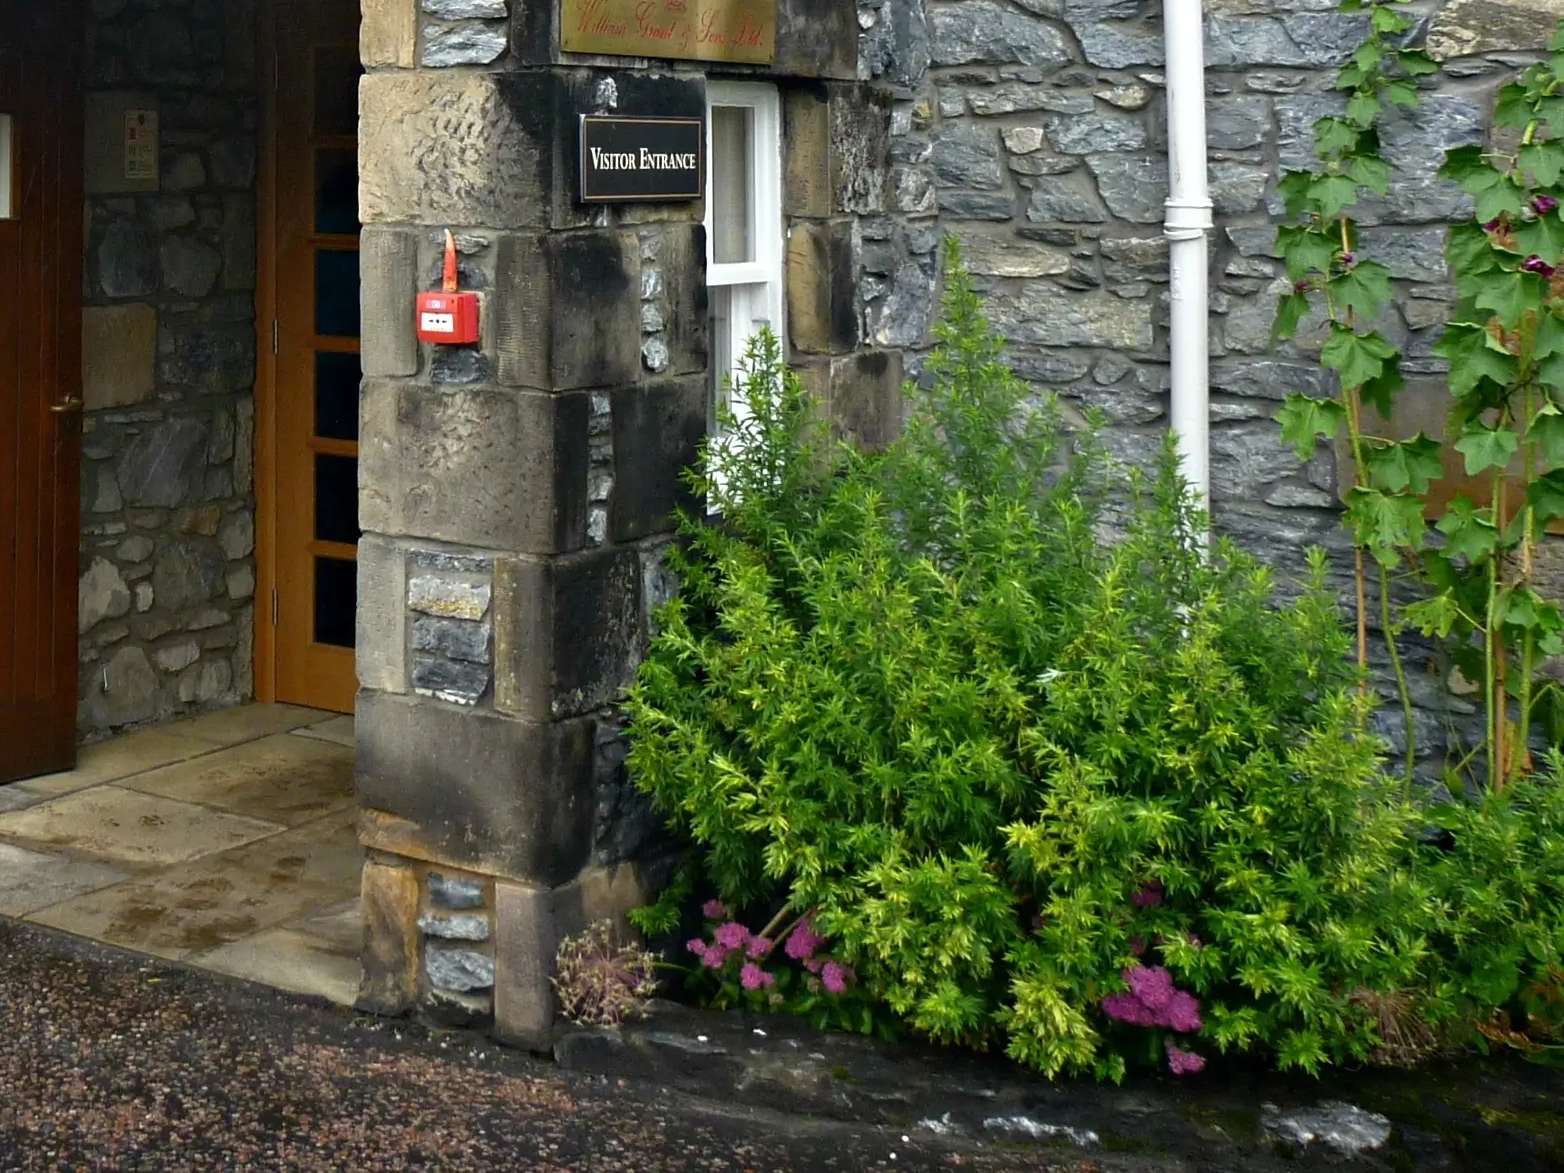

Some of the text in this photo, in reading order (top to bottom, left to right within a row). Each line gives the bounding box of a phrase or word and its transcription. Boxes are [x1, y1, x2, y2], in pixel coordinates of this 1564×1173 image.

[636, 1, 676, 39] Grant
[696, 8, 726, 44] Sons
[590, 147, 696, 170] VISITOR ENTRANCE
